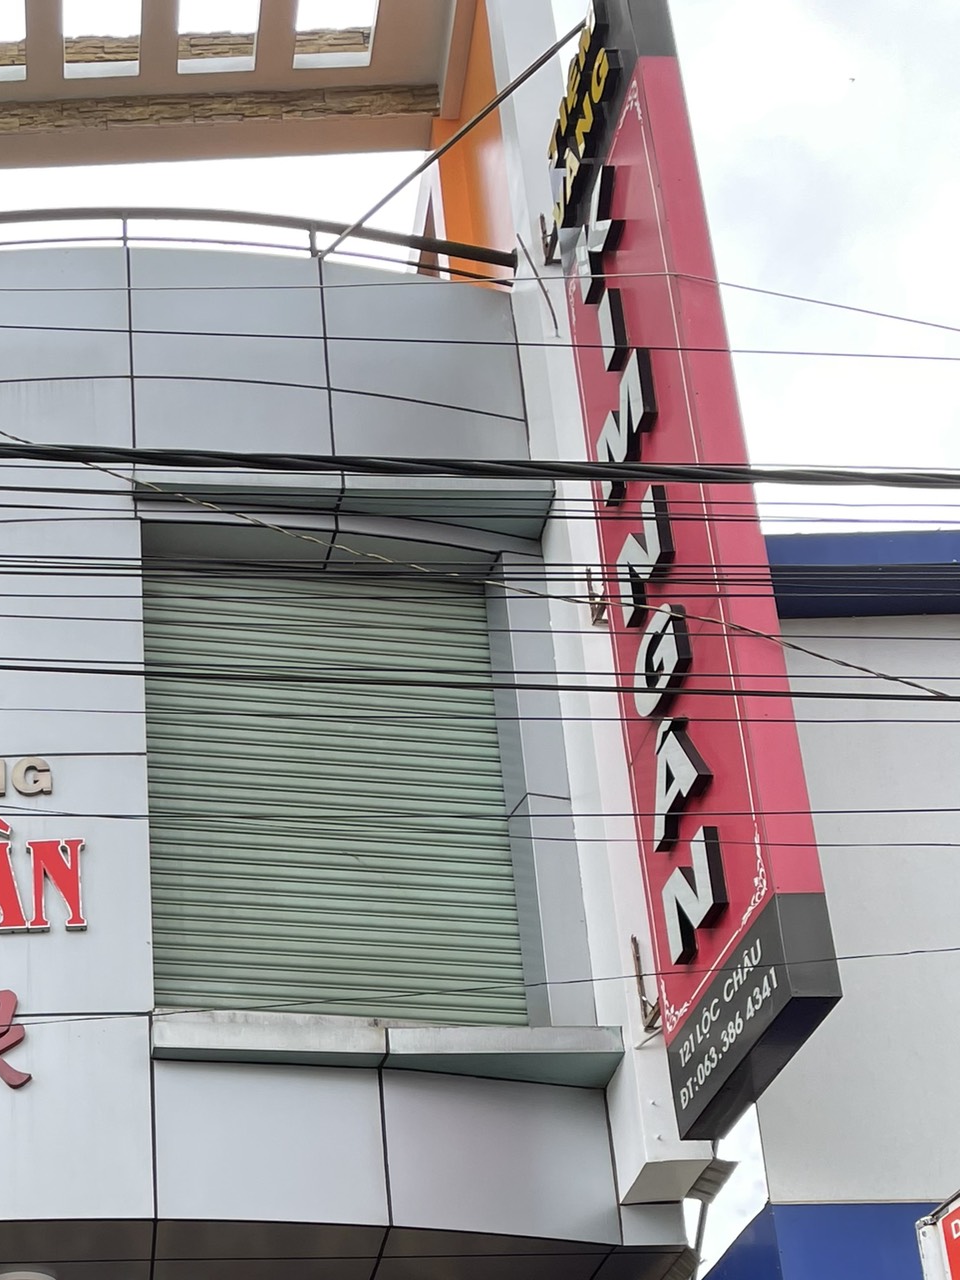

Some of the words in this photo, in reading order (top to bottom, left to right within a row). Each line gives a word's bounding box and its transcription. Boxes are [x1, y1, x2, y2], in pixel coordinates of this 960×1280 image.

[678, 1033, 696, 1068] 121
[696, 998, 721, 1043] LỘC
[723, 938, 762, 1005] CHÂU
